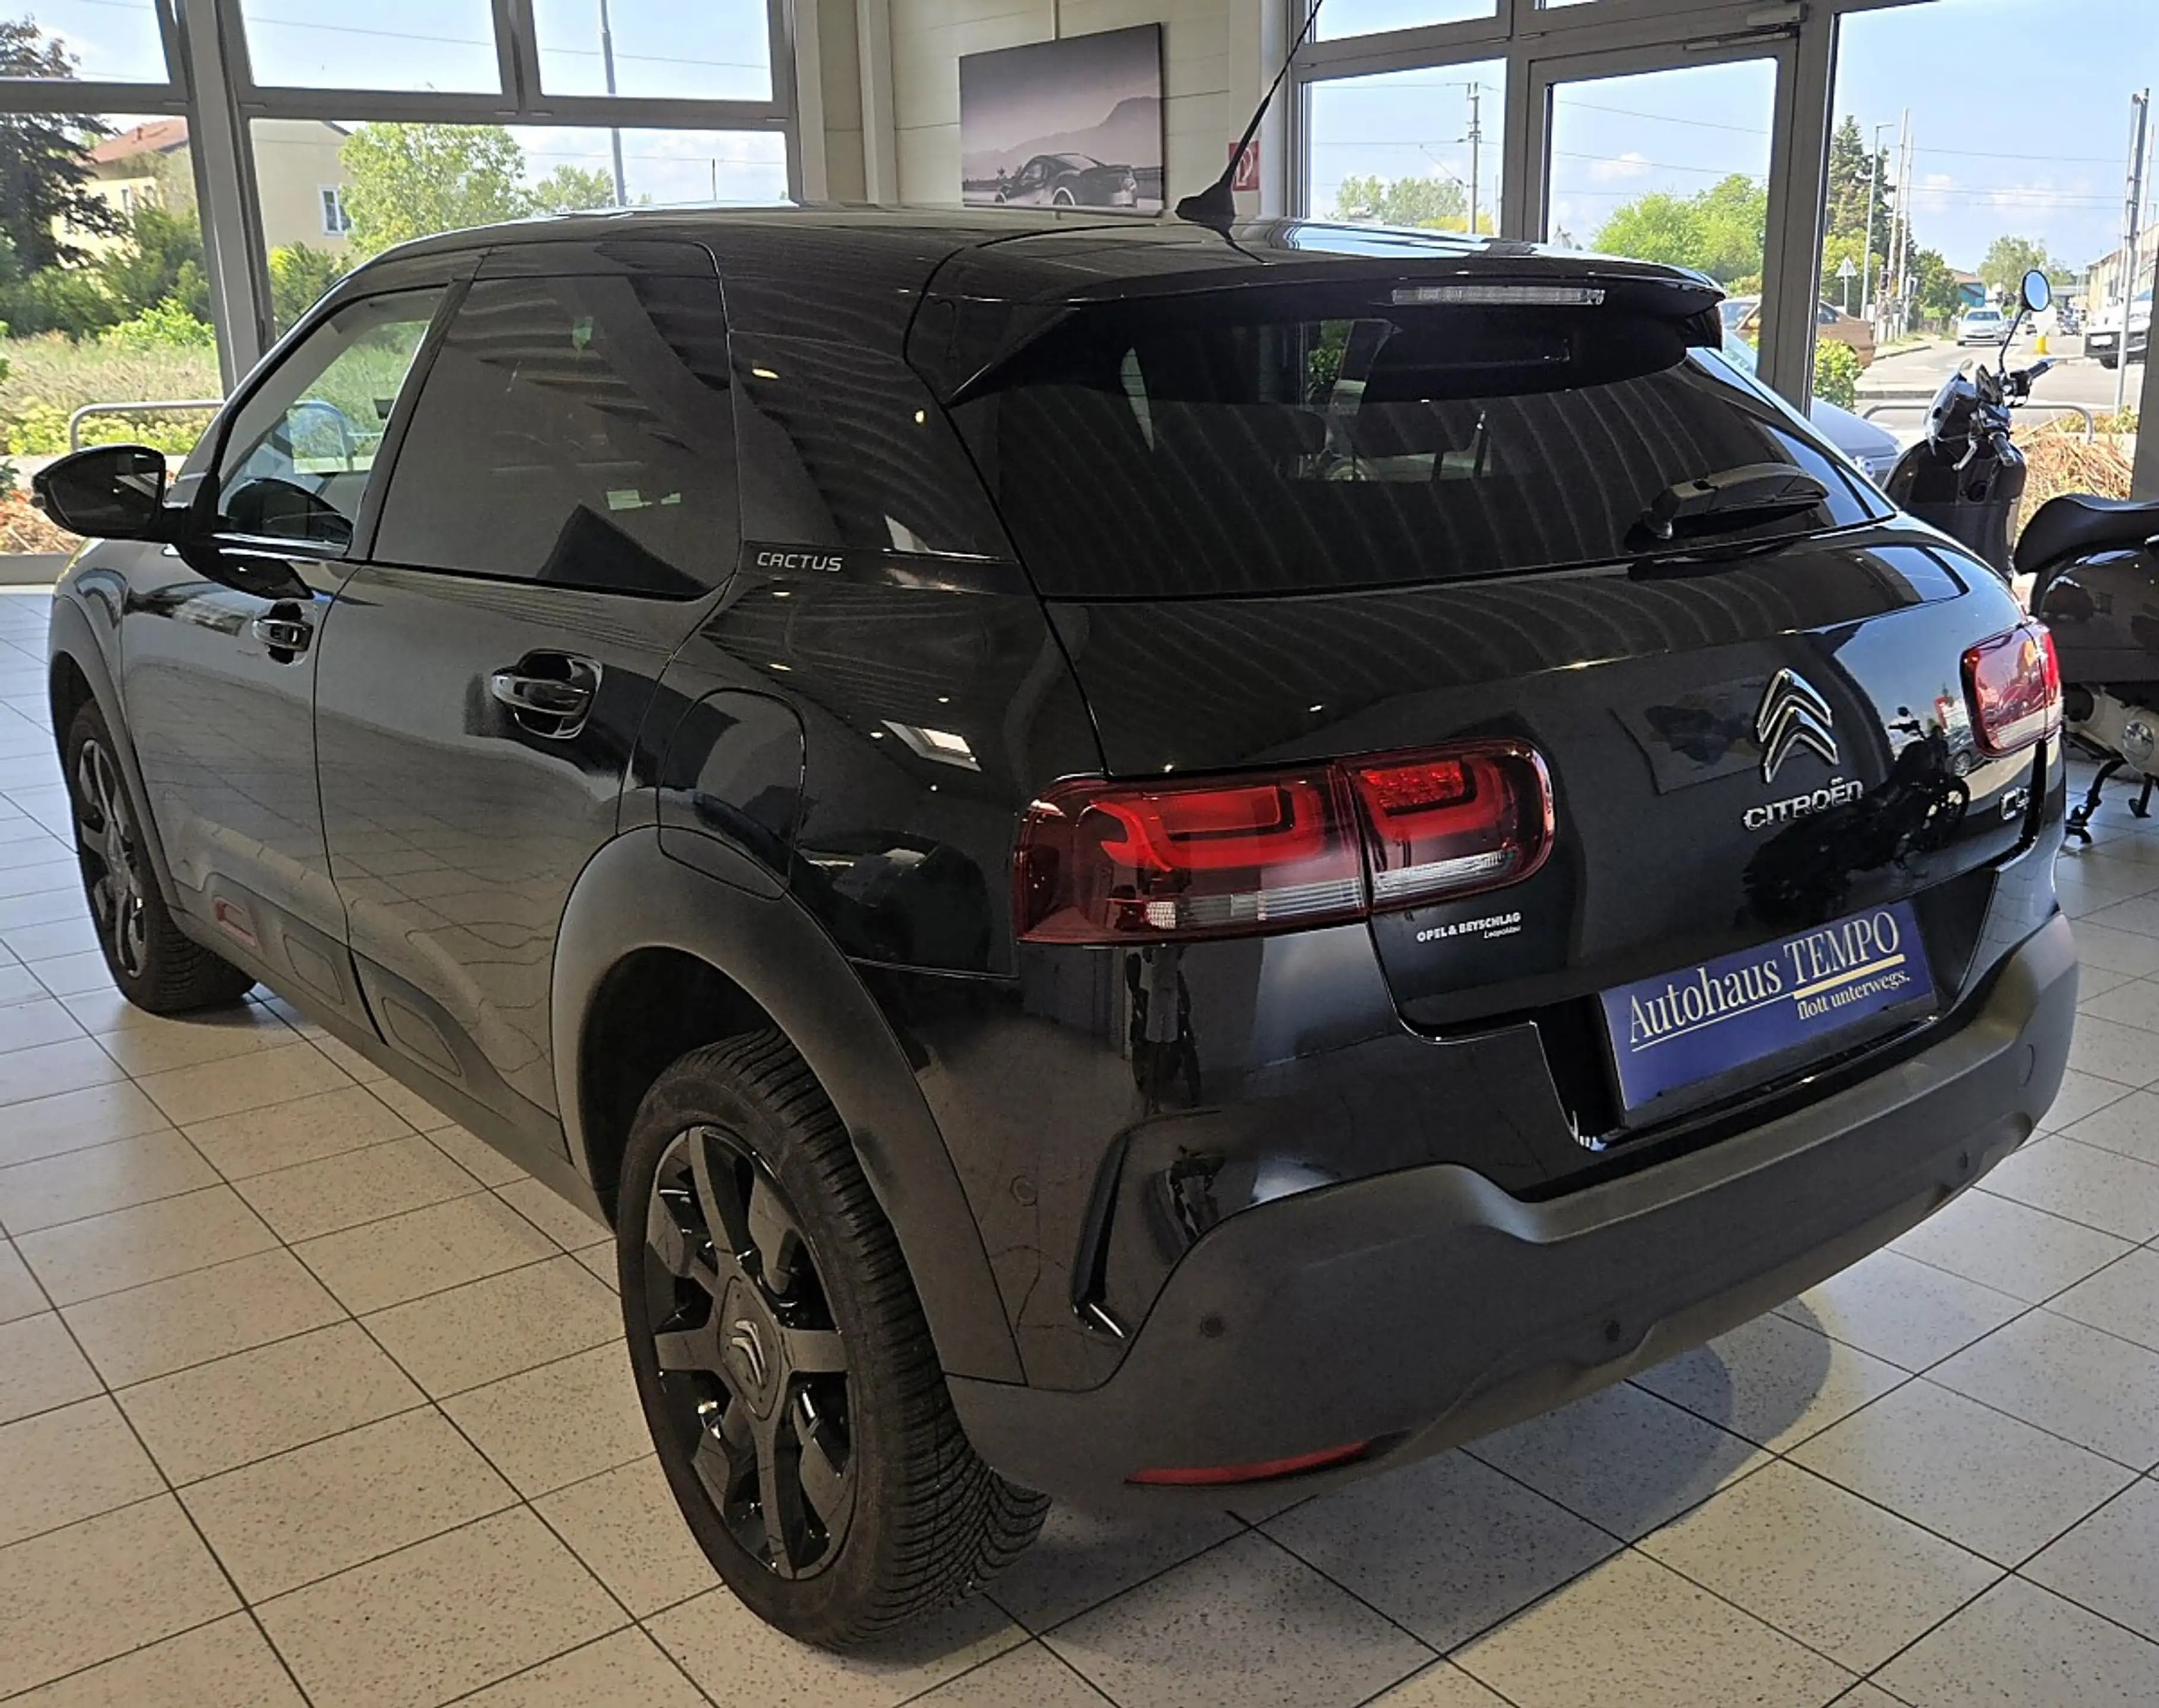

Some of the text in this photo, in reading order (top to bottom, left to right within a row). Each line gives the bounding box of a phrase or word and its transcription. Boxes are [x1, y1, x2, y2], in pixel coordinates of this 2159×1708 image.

[757, 552, 843, 571] CACTUS
[1417, 912, 1521, 942] OPEL & BEYSCHLAG
[1630, 911, 1899, 1043] Autohaus TEMPO
[1797, 970, 1910, 1019] flott unterwegs.
